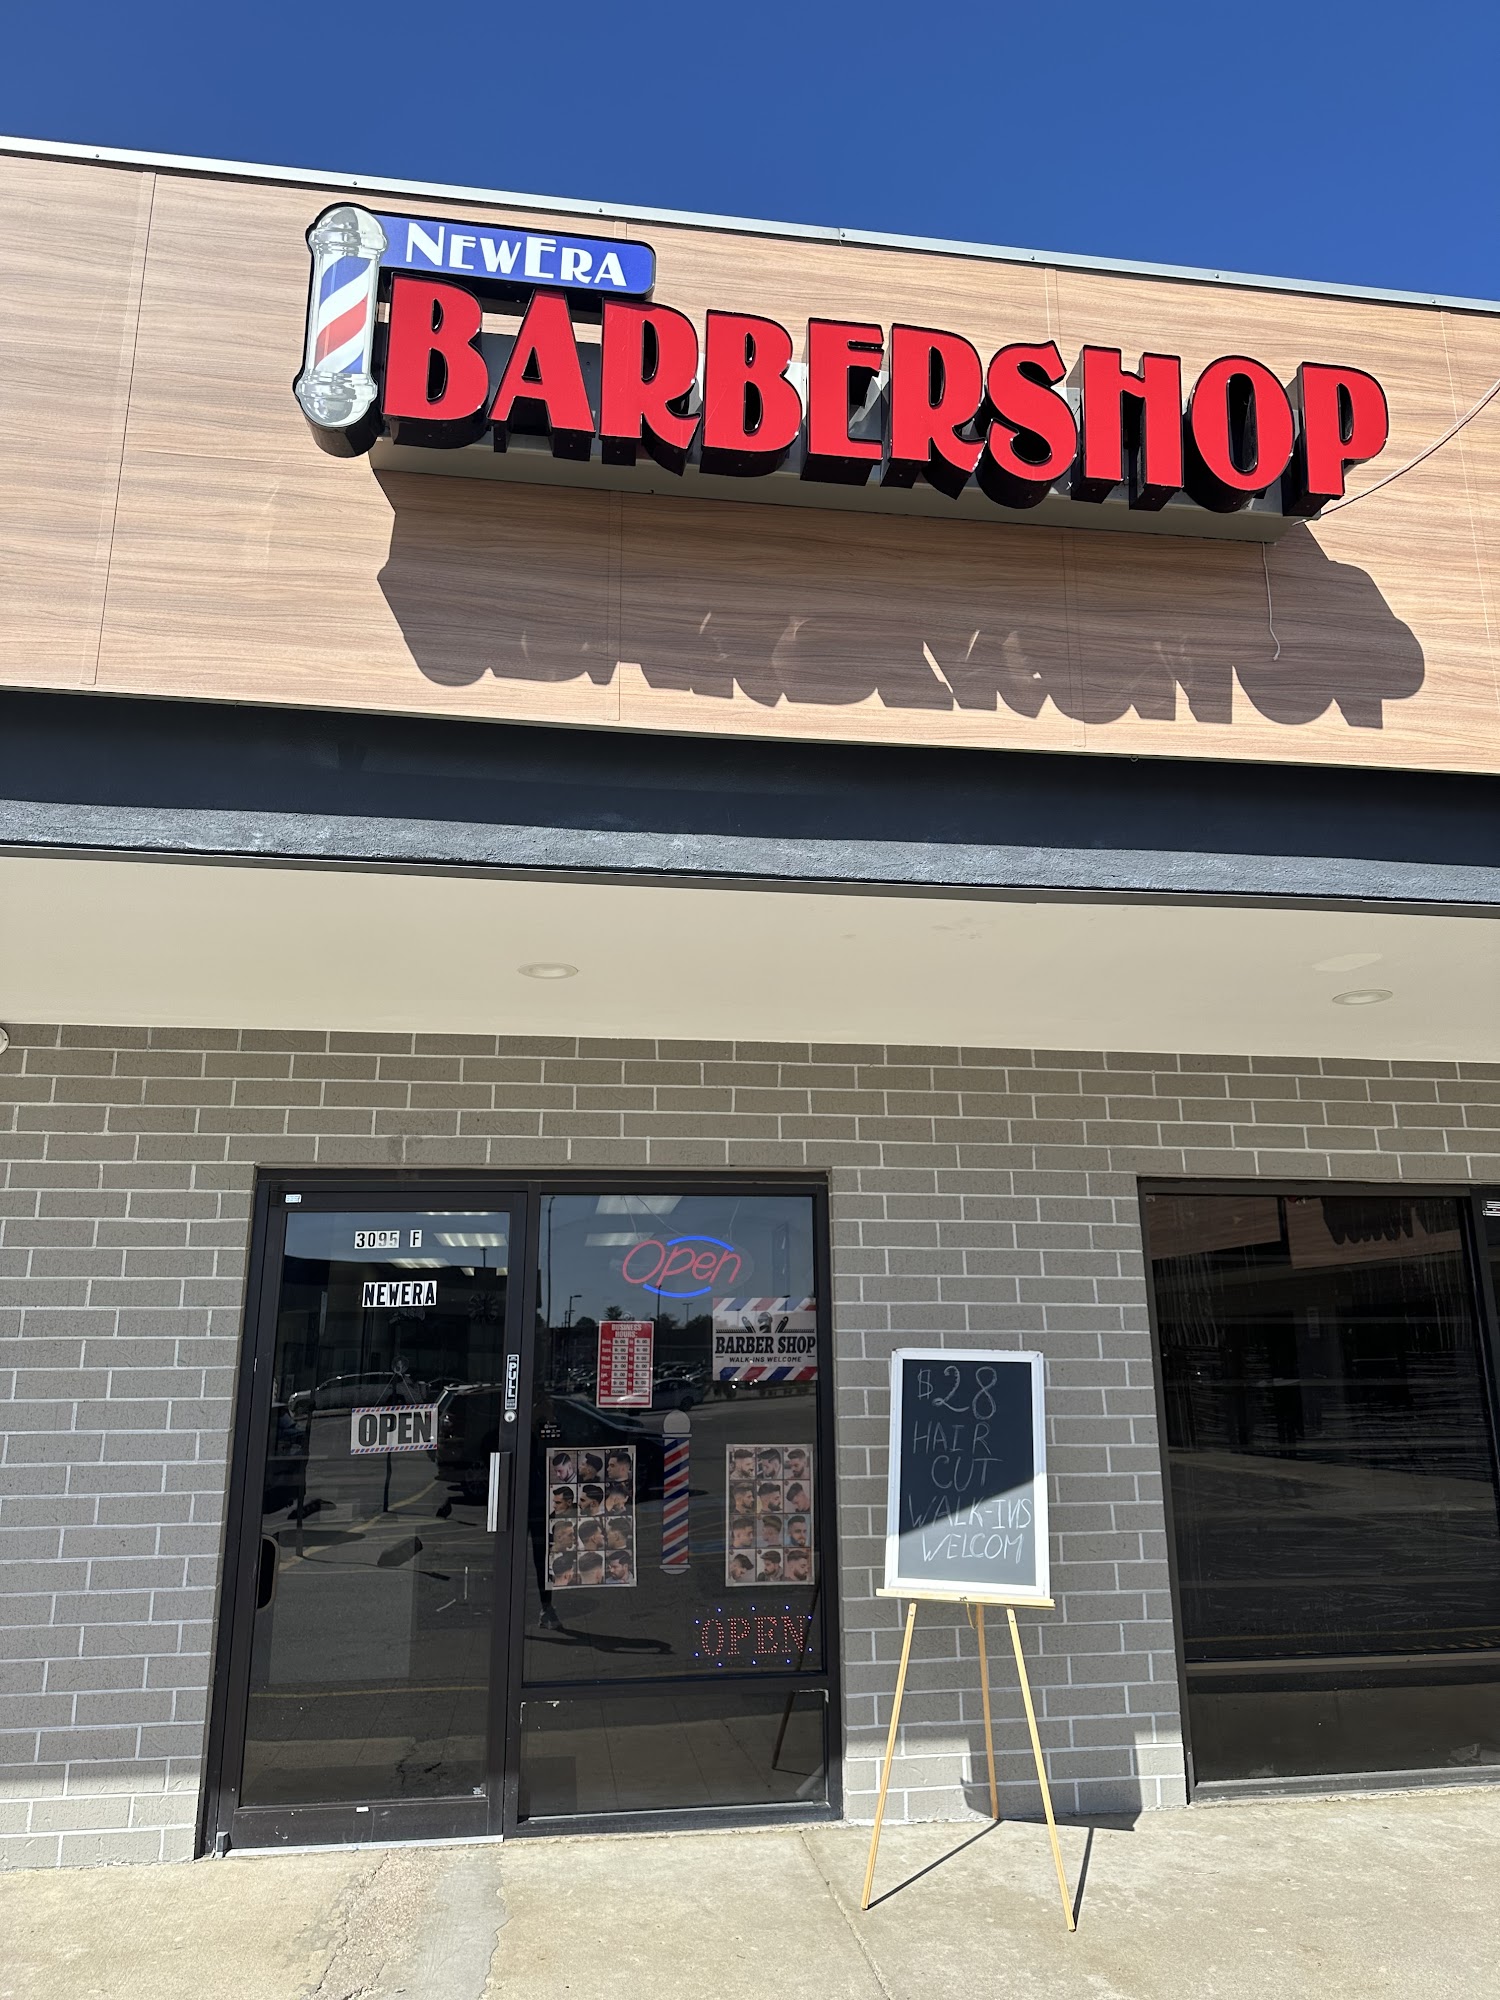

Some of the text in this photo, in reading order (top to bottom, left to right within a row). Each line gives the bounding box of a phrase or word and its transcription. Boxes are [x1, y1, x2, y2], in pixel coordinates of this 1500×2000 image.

[383, 273, 1389, 499] BARBERSHOP
[356, 1231, 420, 1248] 3095 F
[622, 1239, 742, 1288] Open
[363, 1282, 435, 1306] NEWERA
[715, 1336, 816, 1354] BARBER SHOP
[508, 1362, 517, 1398] PULL
[917, 1365, 998, 1420] $28
[358, 1411, 432, 1447] OPEN
[913, 1420, 991, 1455] HAIR
[931, 1454, 1003, 1492] CUT
[908, 1494, 1032, 1530] WALK-INS
[922, 1532, 1023, 1564] WELCOM
[701, 1615, 807, 1657] OPEN
